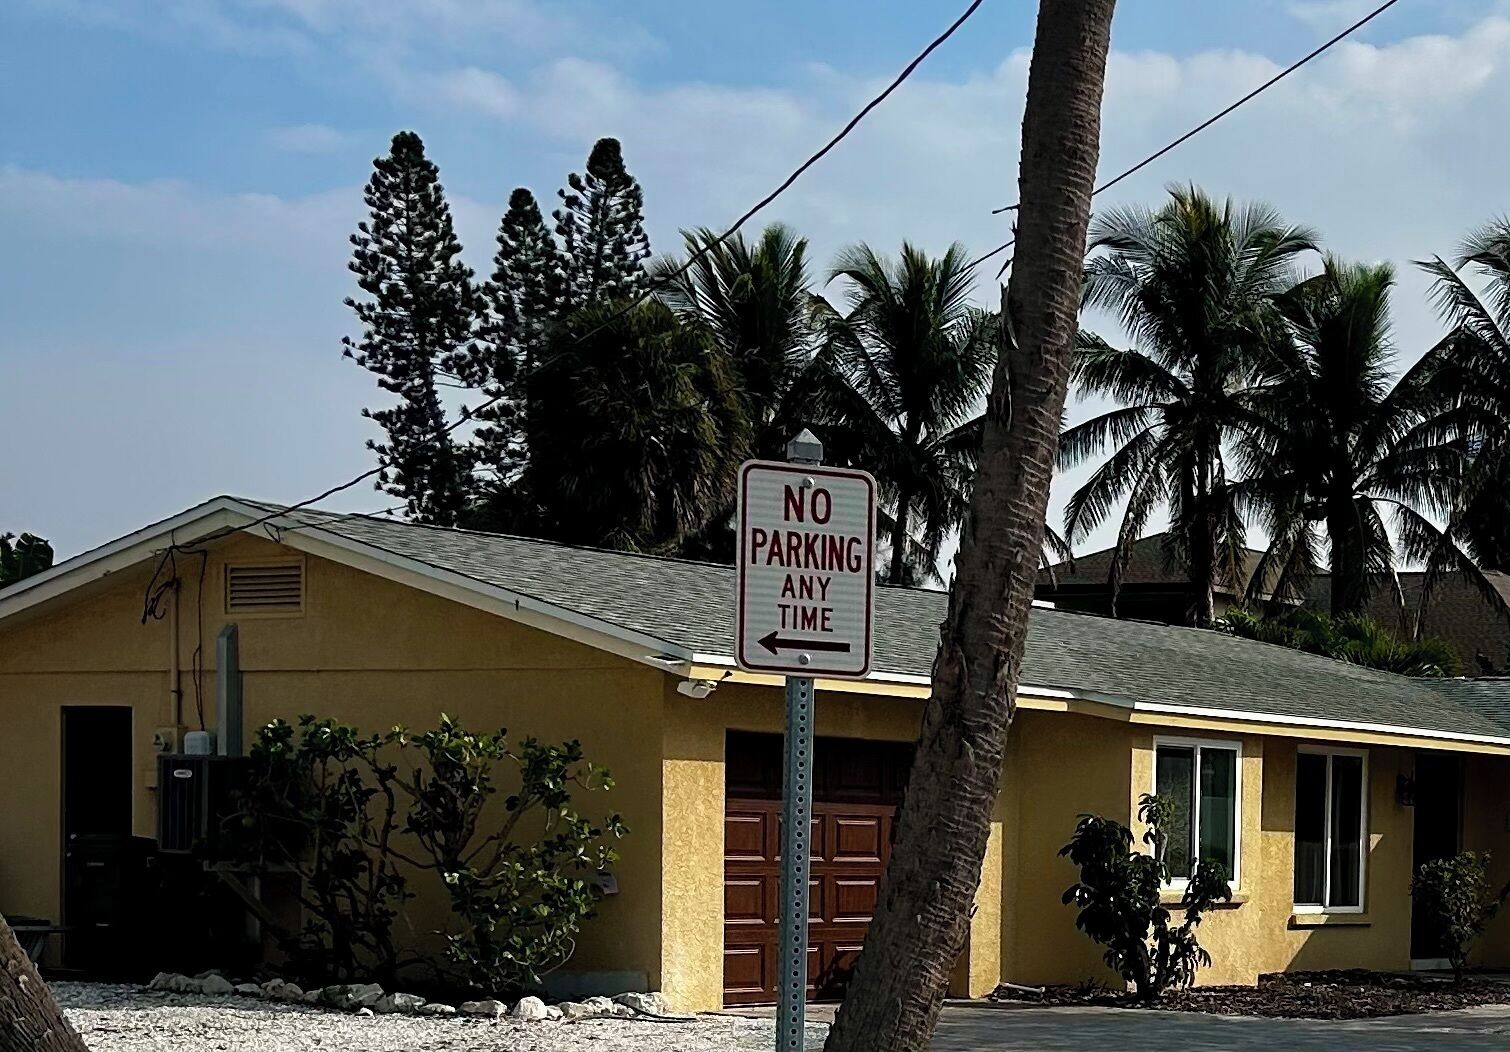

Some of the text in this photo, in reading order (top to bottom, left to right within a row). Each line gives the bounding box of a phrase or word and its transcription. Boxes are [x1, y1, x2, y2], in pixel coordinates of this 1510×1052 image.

[784, 484, 831, 524] NO
[751, 528, 861, 573] PARKING
[781, 573, 832, 601] ANY
[778, 603, 833, 632] TIME
